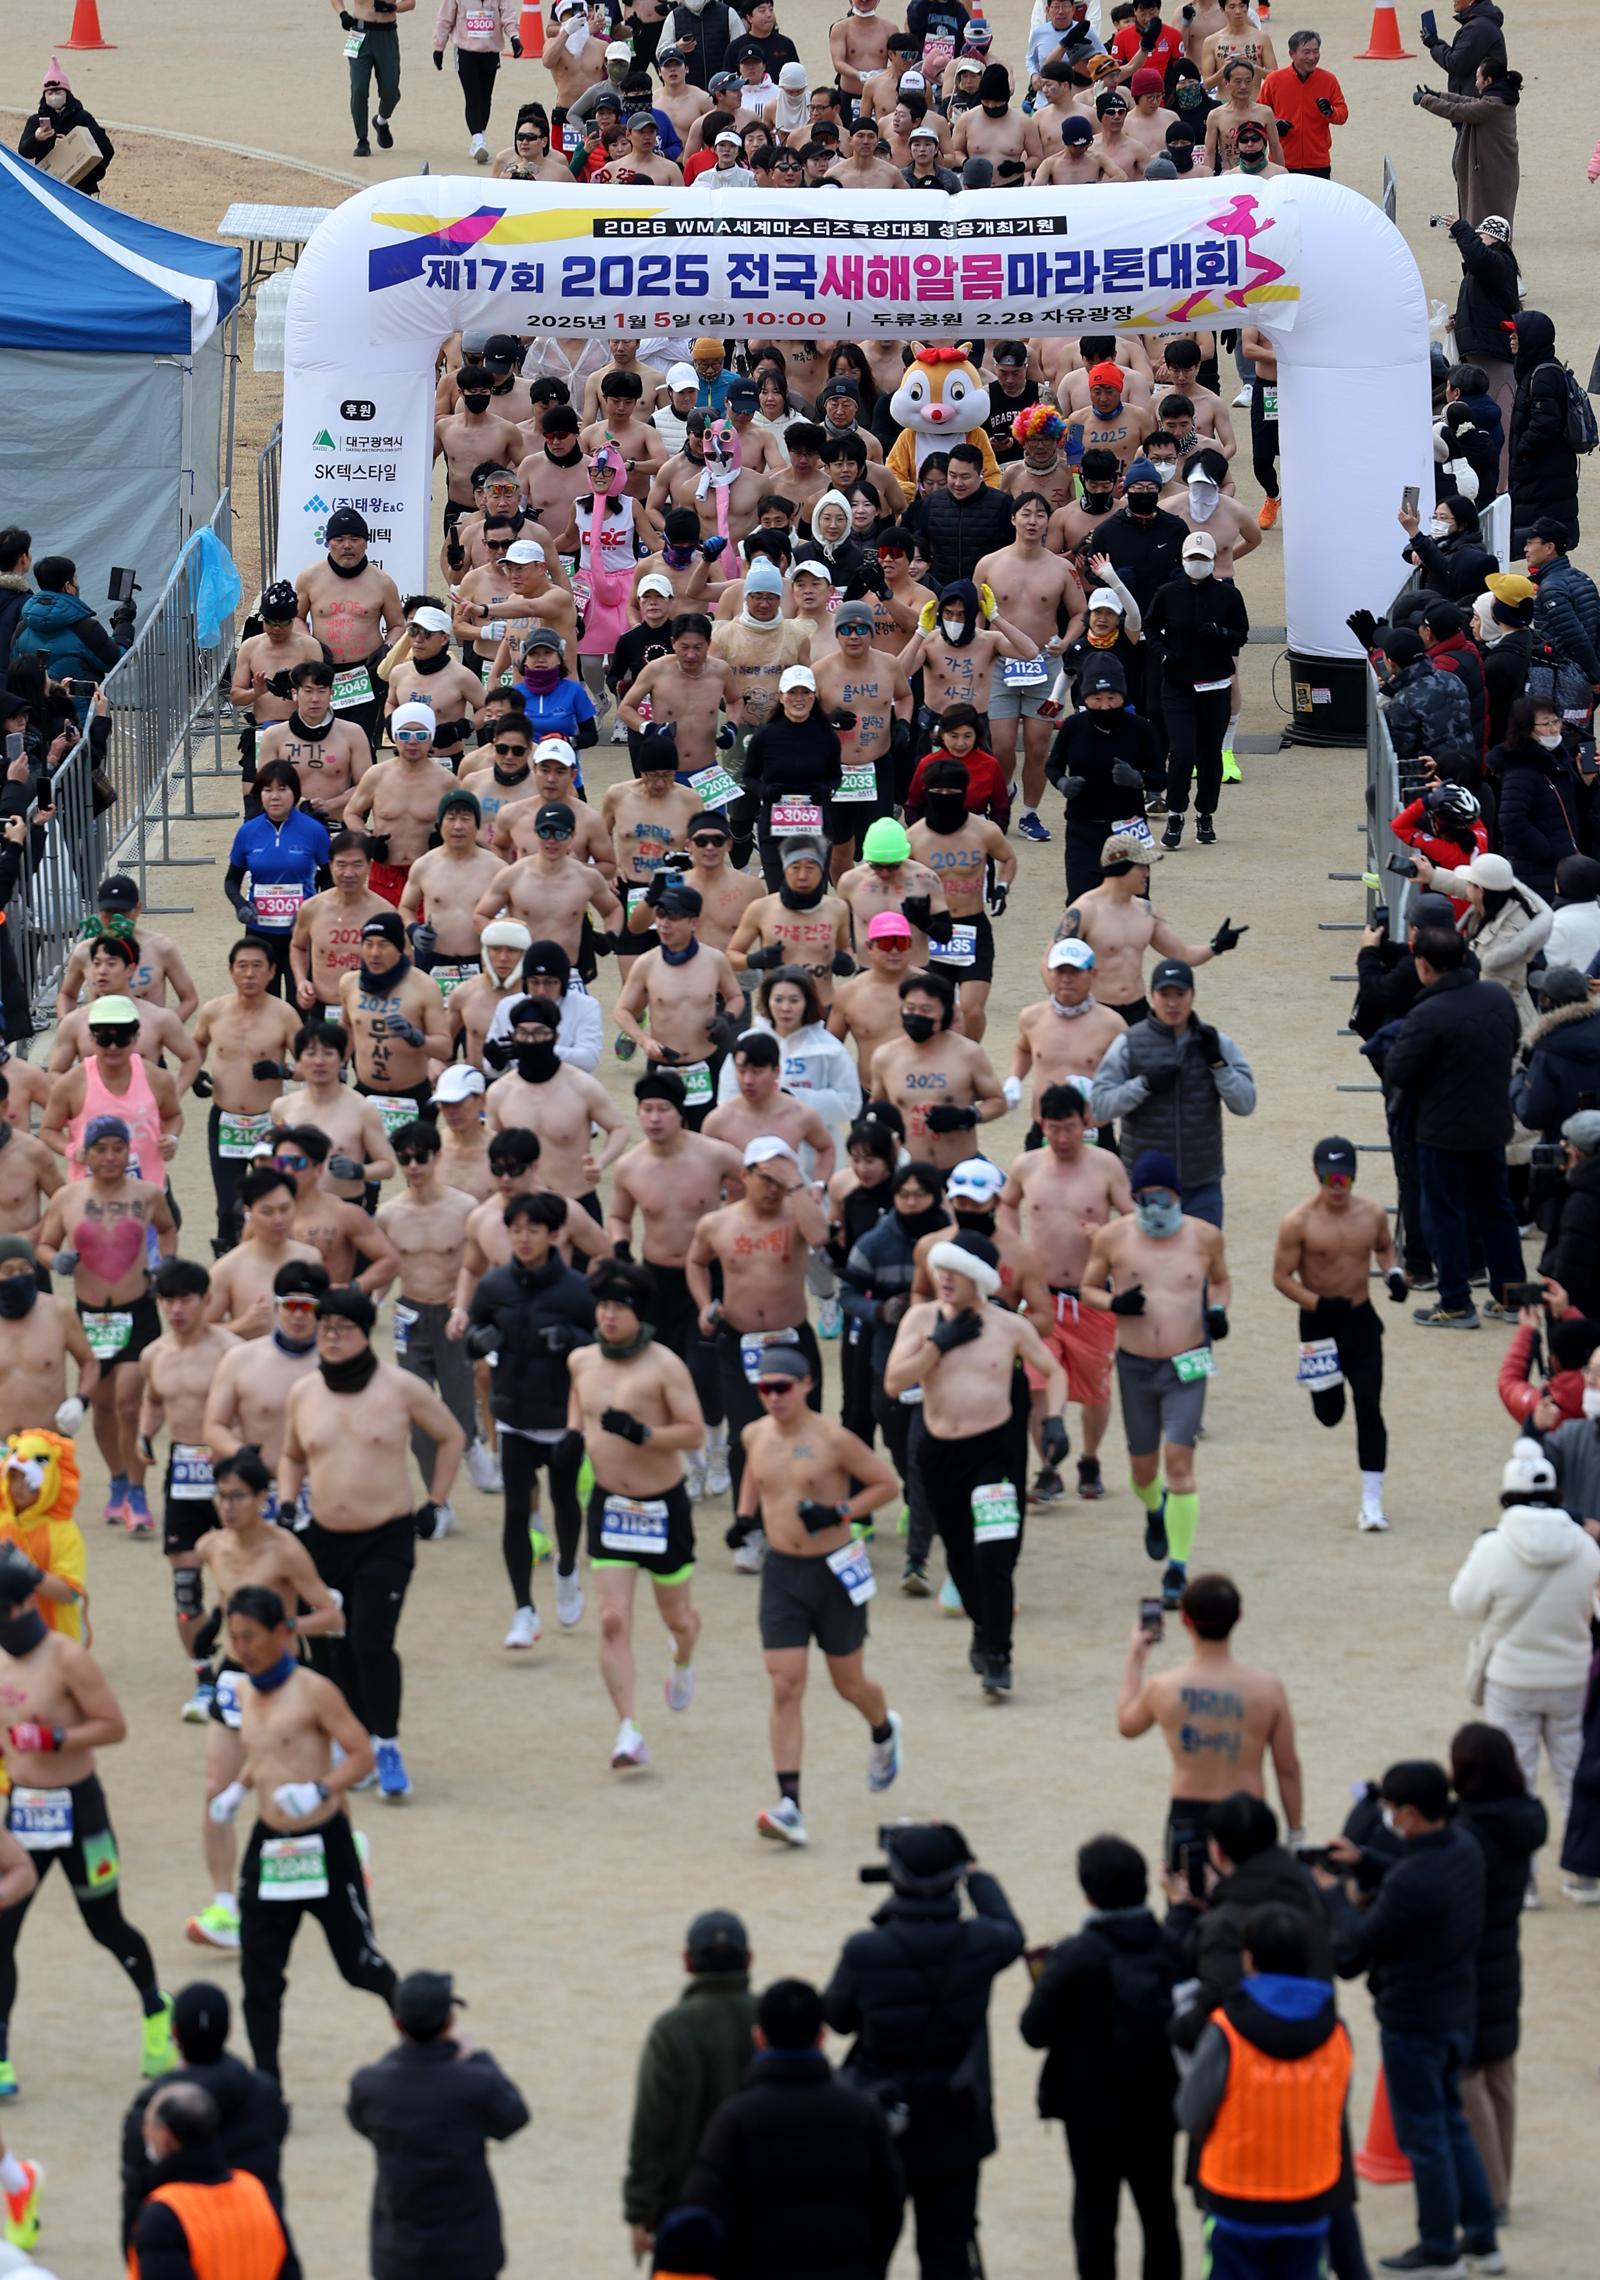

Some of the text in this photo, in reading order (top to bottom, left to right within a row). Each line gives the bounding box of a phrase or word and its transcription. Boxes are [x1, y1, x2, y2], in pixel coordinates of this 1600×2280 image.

[603, 217, 1055, 238] 2026 WMA세계마스터즈육상대회 성공개최기원
[425, 257, 545, 294] 제17회
[561, 253, 710, 298] 2025
[527, 305, 1135, 330] 2025년 1월 5일 (일) 10:00 두류공원 2.28 자유광장
[345, 403, 371, 417] 후원
[990, 409, 1020, 429] BEAST
[346, 435, 403, 448] 대구광역시
[1090, 427, 1128, 443] 2025
[314, 463, 397, 482] SK텍스타일
[1014, 661, 1043, 675] 1123
[337, 678, 369, 696] 2049
[842, 682, 879, 704] 을사년
[706, 775, 736, 795] 2032
[841, 774, 873, 788] 2033
[783, 808, 818, 822] 3069
[930, 849, 983, 870] 2025
[329, 929, 362, 944] 202
[784, 1057, 806, 1076] 25
[906, 1073, 948, 1090] 2025
[234, 1131, 259, 1143] 216
